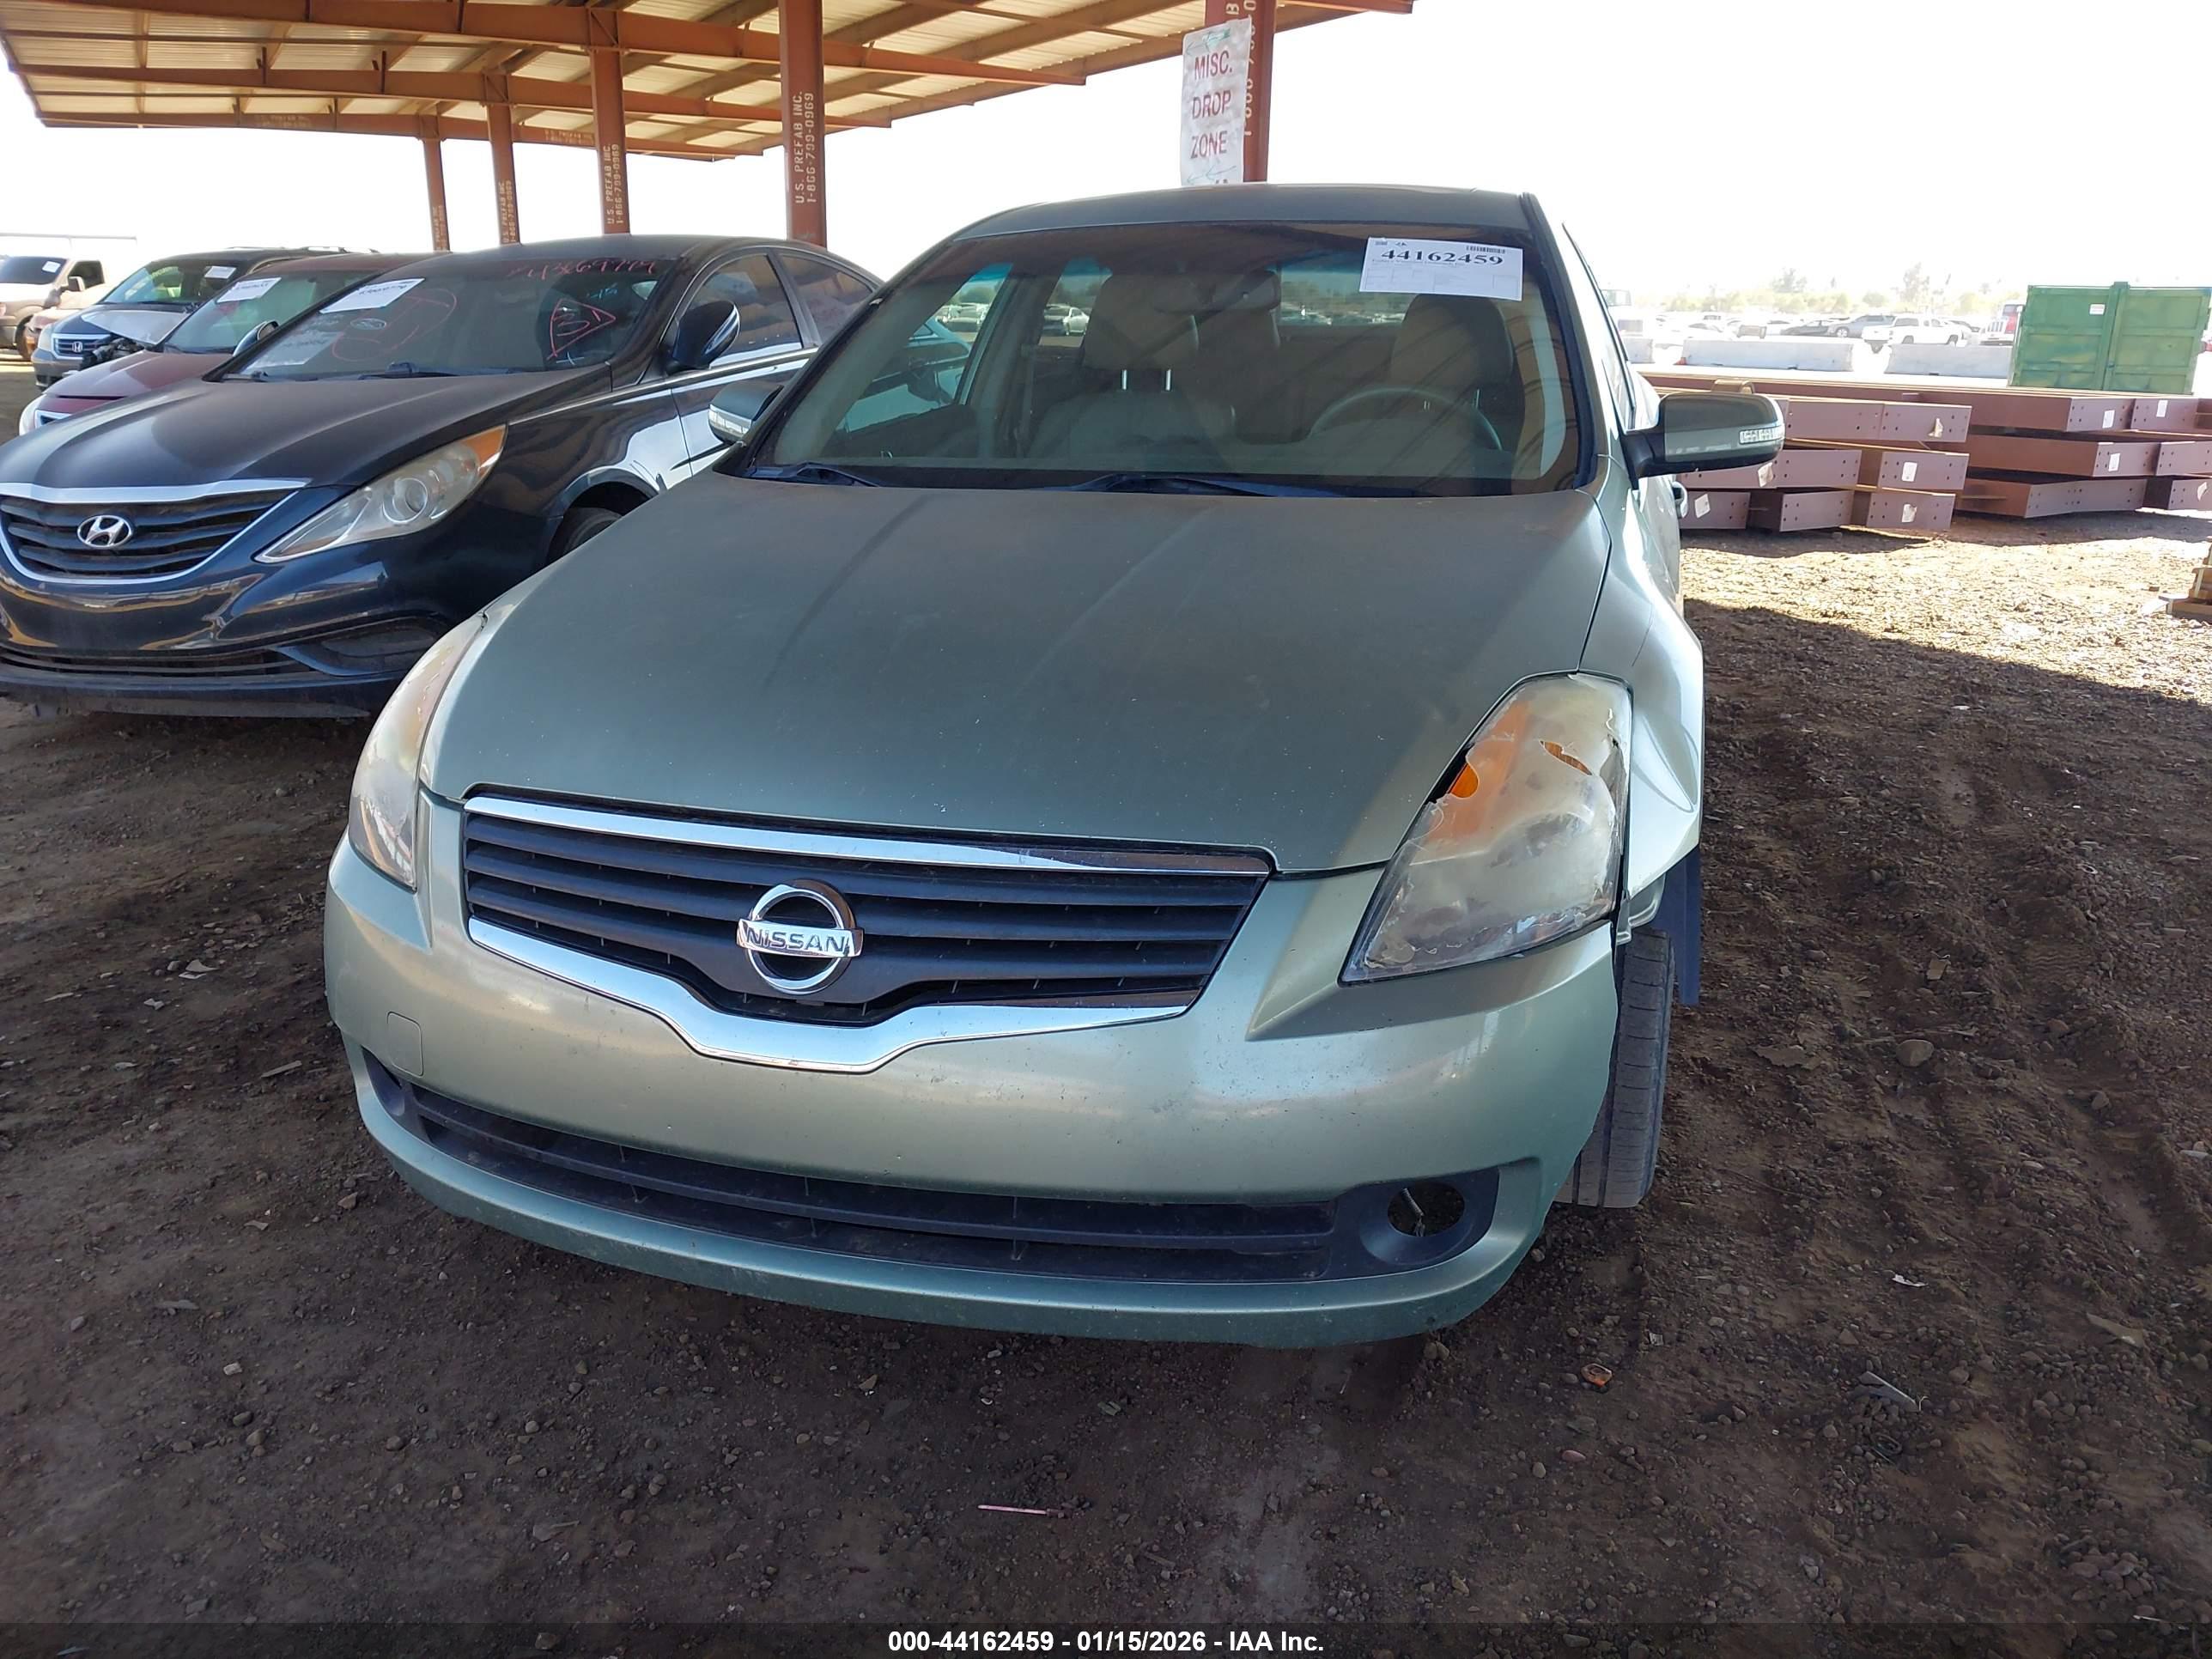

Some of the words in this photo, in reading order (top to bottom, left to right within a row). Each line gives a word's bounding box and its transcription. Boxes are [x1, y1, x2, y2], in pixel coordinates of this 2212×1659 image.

[1194, 50, 1233, 81] MISC.
[793, 91, 803, 116] INC.
[1192, 90, 1231, 119] DROP
[793, 123, 805, 173] PREFAB
[804, 93, 817, 203] 1-866-799-0969
[1190, 131, 1228, 160] ZONE
[795, 179, 805, 204] U.S.
[1381, 249, 1504, 265] 44162459
[746, 927, 846, 952] NISSAN
